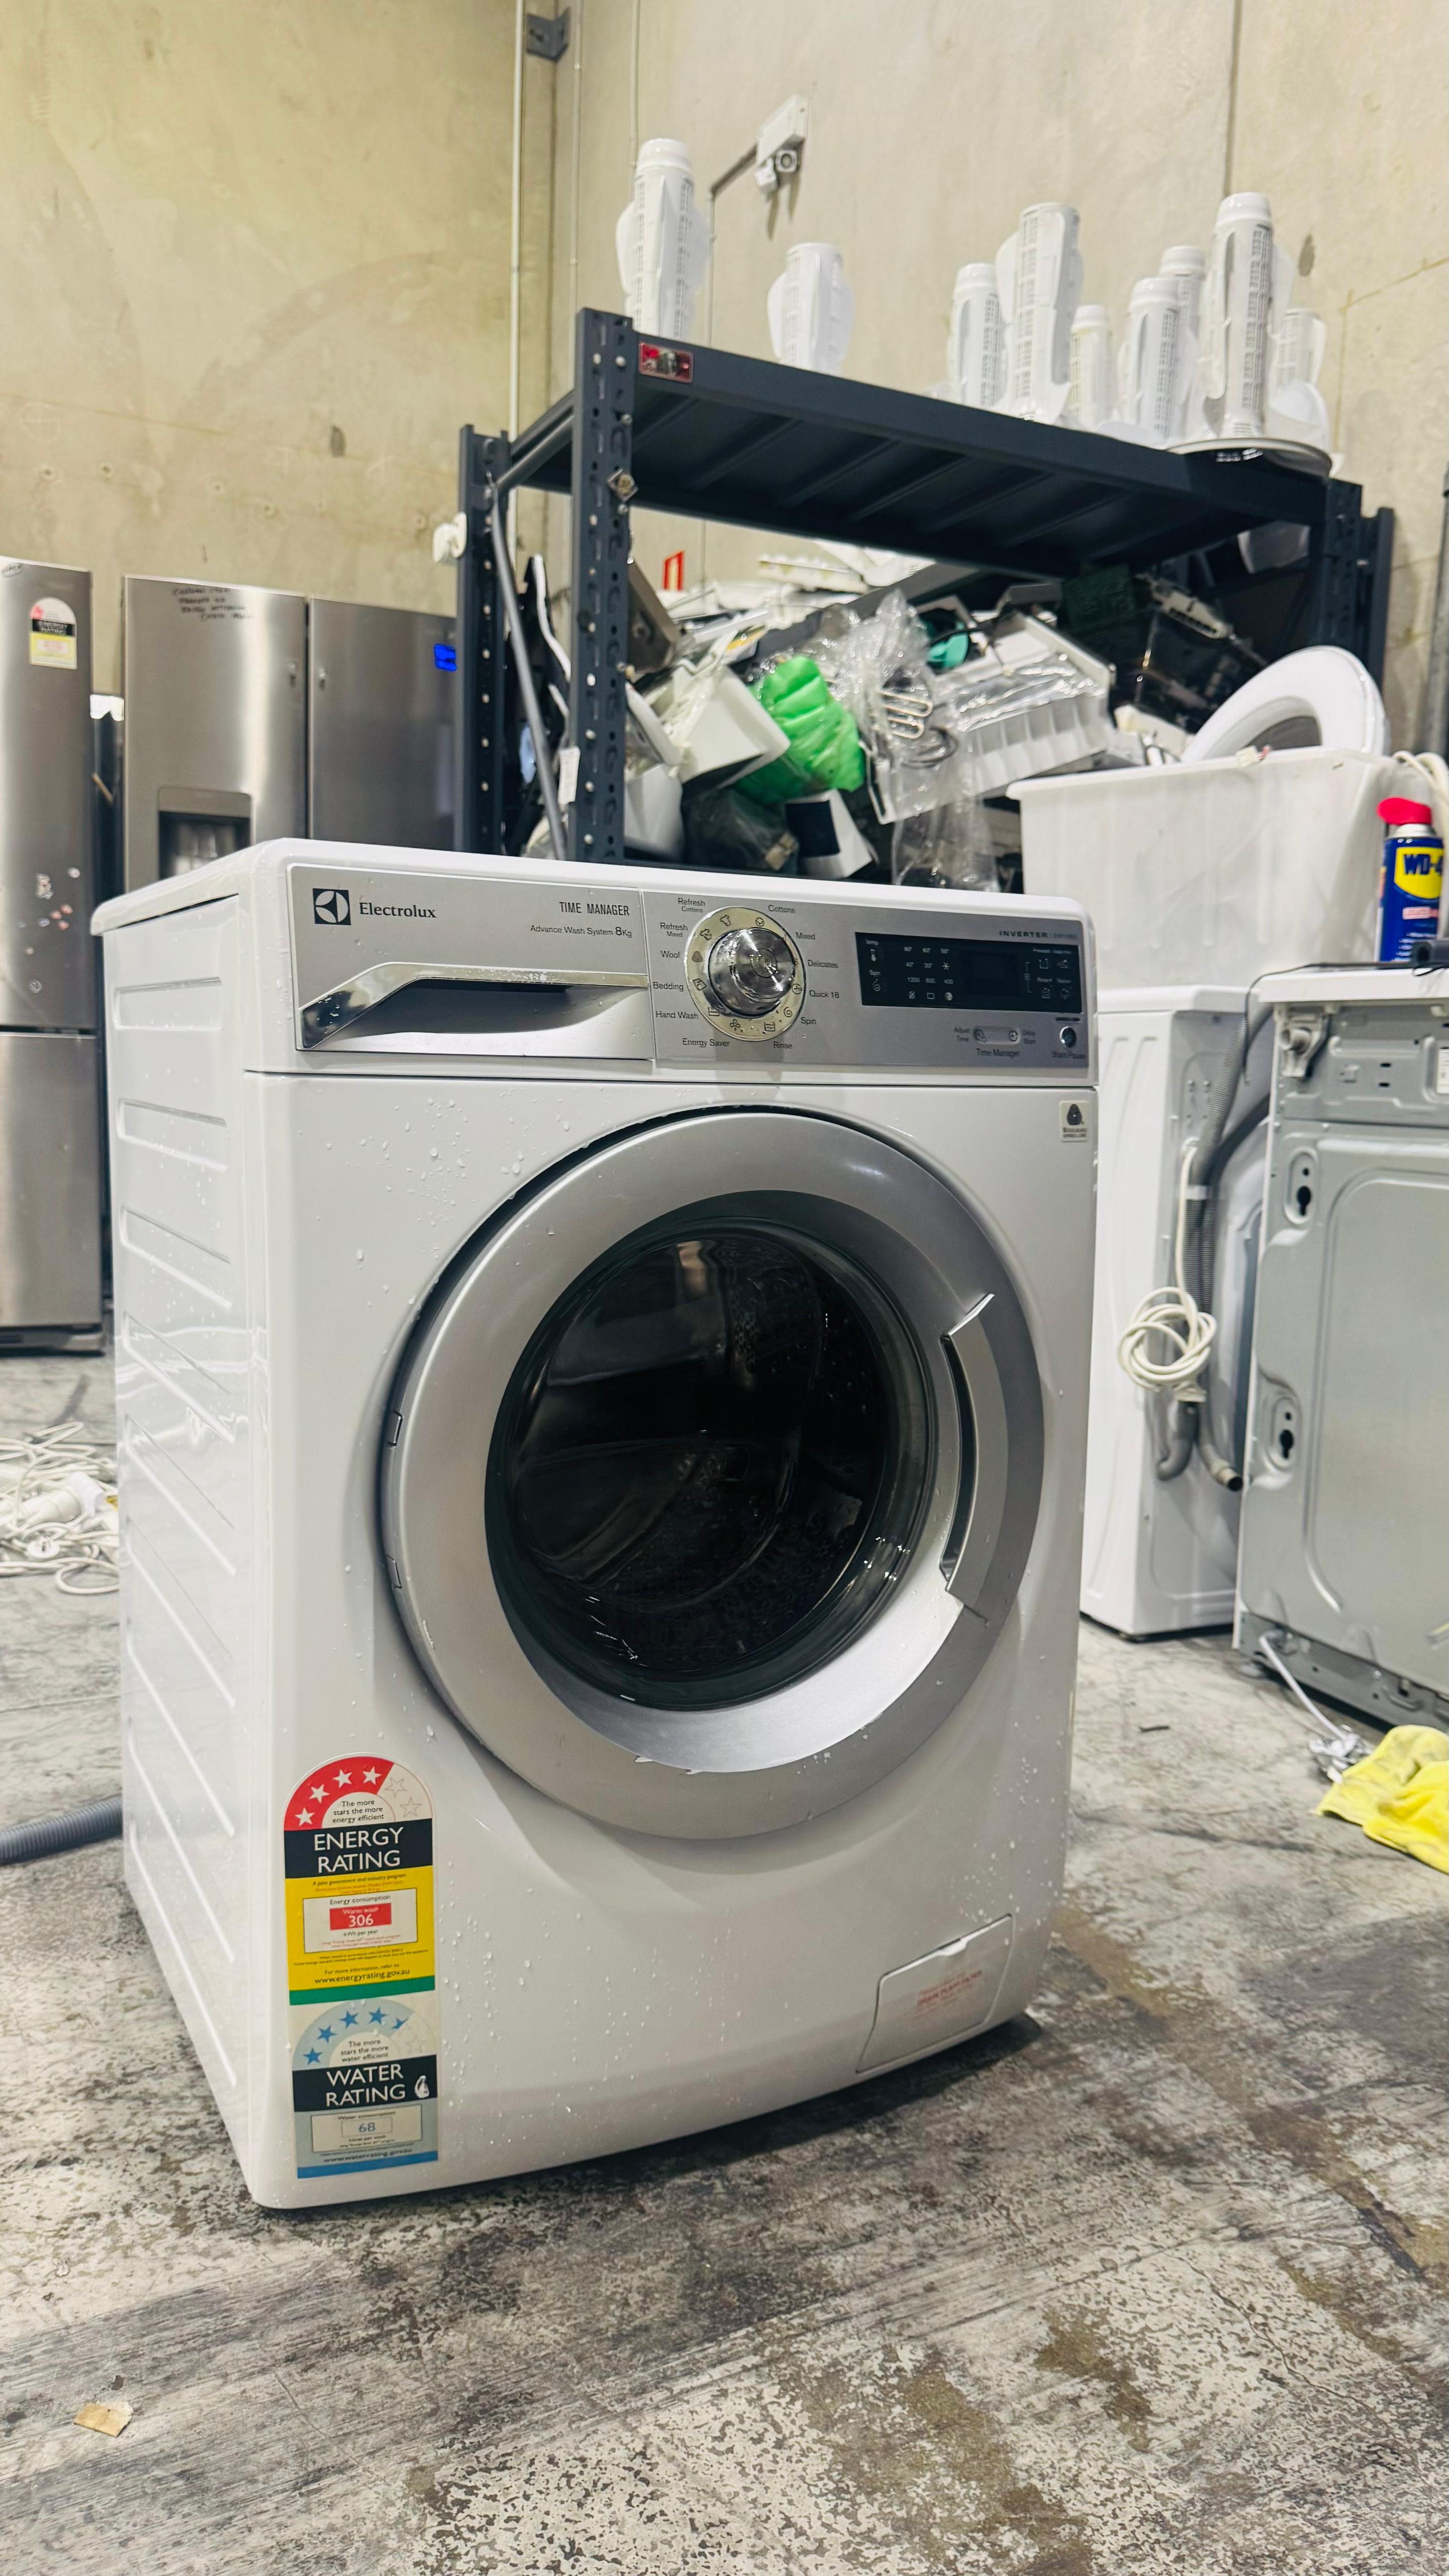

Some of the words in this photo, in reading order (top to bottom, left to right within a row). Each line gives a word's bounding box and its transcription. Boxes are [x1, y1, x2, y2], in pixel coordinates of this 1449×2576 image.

[678, 898, 705, 906] Refresh
[359, 902, 436, 918] Electrolux
[559, 902, 582, 913] TIME
[587, 904, 629, 916] MANAGER
[768, 905, 795, 913] Cottons
[564, 926, 585, 934] Wash
[587, 927, 613, 936] System
[660, 922, 688, 930] Refresh
[653, 982, 684, 992] Bedding
[809, 990, 829, 998] Quick
[800, 1017, 817, 1025] Spin
[682, 1038, 707, 1048] Energy
[773, 1041, 793, 1049] Rinse
[976, 1048, 992, 1056] Time
[314, 1827, 404, 1851] ENERGY
[318, 1850, 400, 1873] RATING
[352, 1895, 390, 1903] consumption
[349, 1914, 374, 1927] 306
[314, 1969, 410, 1984] www.energyrating.gov.au
[327, 2064, 404, 2086] WATER
[327, 2084, 405, 2107] RATING
[359, 2122, 376, 2133] 68
